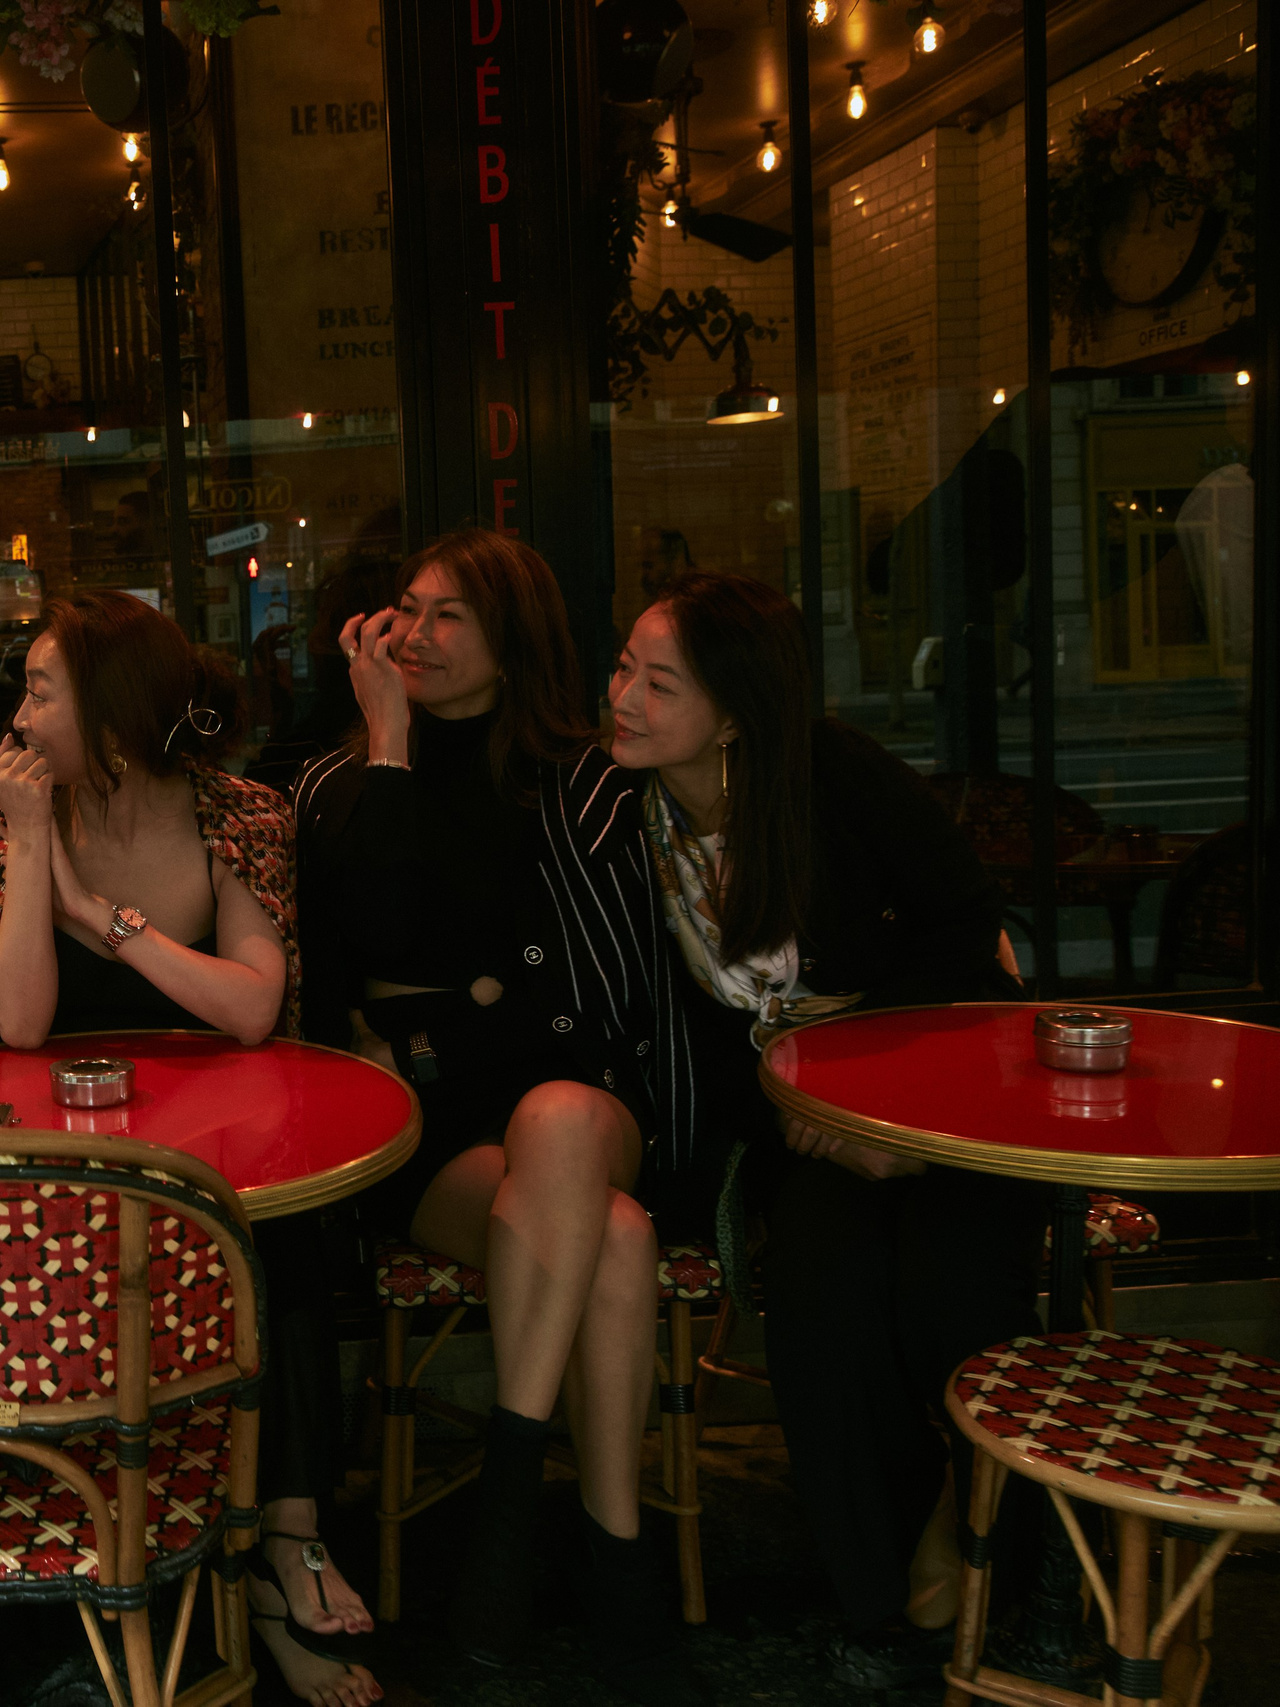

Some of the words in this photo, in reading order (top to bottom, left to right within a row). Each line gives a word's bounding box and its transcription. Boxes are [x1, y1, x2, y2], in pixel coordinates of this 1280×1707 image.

[290, 103, 318, 136] LE
[1139, 320, 1188, 347] OFFICE
[488, 401, 521, 536] DE
